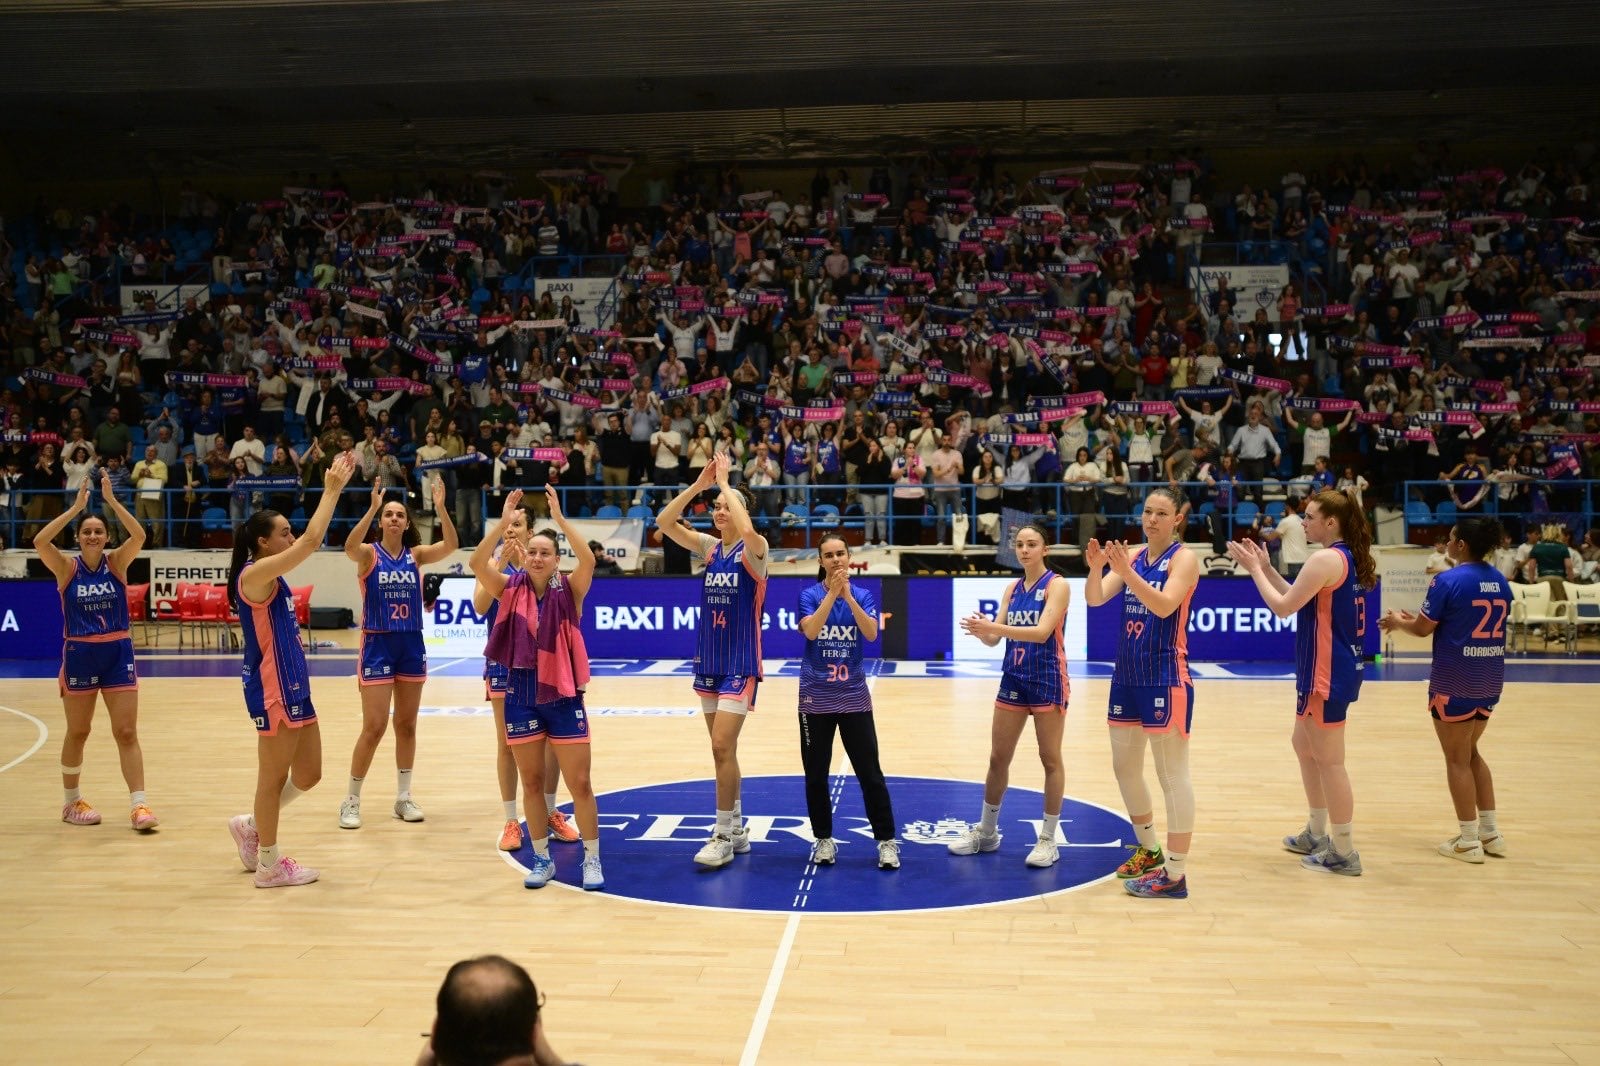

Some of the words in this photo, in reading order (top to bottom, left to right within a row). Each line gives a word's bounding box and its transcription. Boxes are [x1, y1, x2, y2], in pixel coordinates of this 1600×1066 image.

[547, 283, 572, 292] BAXI
[738, 293, 757, 301] UNI
[1302, 308, 1322, 316] UNI
[459, 319, 478, 327] UNI
[1418, 320, 1440, 329] UNI
[927, 329, 947, 338] UNI
[1018, 327, 1038, 337] UNI
[331, 337, 350, 345] UNI
[590, 351, 609, 361] UNI
[293, 358, 314, 367] UNI
[1368, 358, 1389, 367] UNI
[434, 365, 454, 373] UNI
[182, 373, 204, 383] UNI
[928, 372, 947, 383] UNI
[1231, 370, 1252, 383] UNI
[352, 378, 373, 388] UNI
[581, 378, 601, 387] UNI
[548, 388, 570, 400] UNI
[668, 387, 689, 400] UNI
[1042, 397, 1064, 407] UNI
[1117, 402, 1139, 412] UNI
[1294, 400, 1317, 410] UNI
[1452, 402, 1477, 411] UNI
[1550, 401, 1576, 411] UNI
[781, 407, 801, 418] UNI
[1014, 411, 1039, 422] UNI
[1418, 411, 1443, 422] UNI
[4, 434, 28, 442] UNI
[990, 433, 1013, 443] UNI
[508, 449, 530, 459] UNI
[378, 571, 416, 585] BAXI
[704, 572, 739, 588] BAXI
[77, 581, 116, 598] BAXI
[389, 603, 410, 620] 20
[595, 606, 664, 631] BAXI
[711, 609, 727, 631] 14
[1007, 609, 1040, 626] BAXI
[1471, 598, 1508, 639] 22
[817, 625, 858, 642] BAXI
[1126, 620, 1145, 640] 99
[1012, 647, 1026, 667] 17
[825, 663, 850, 682] 30
